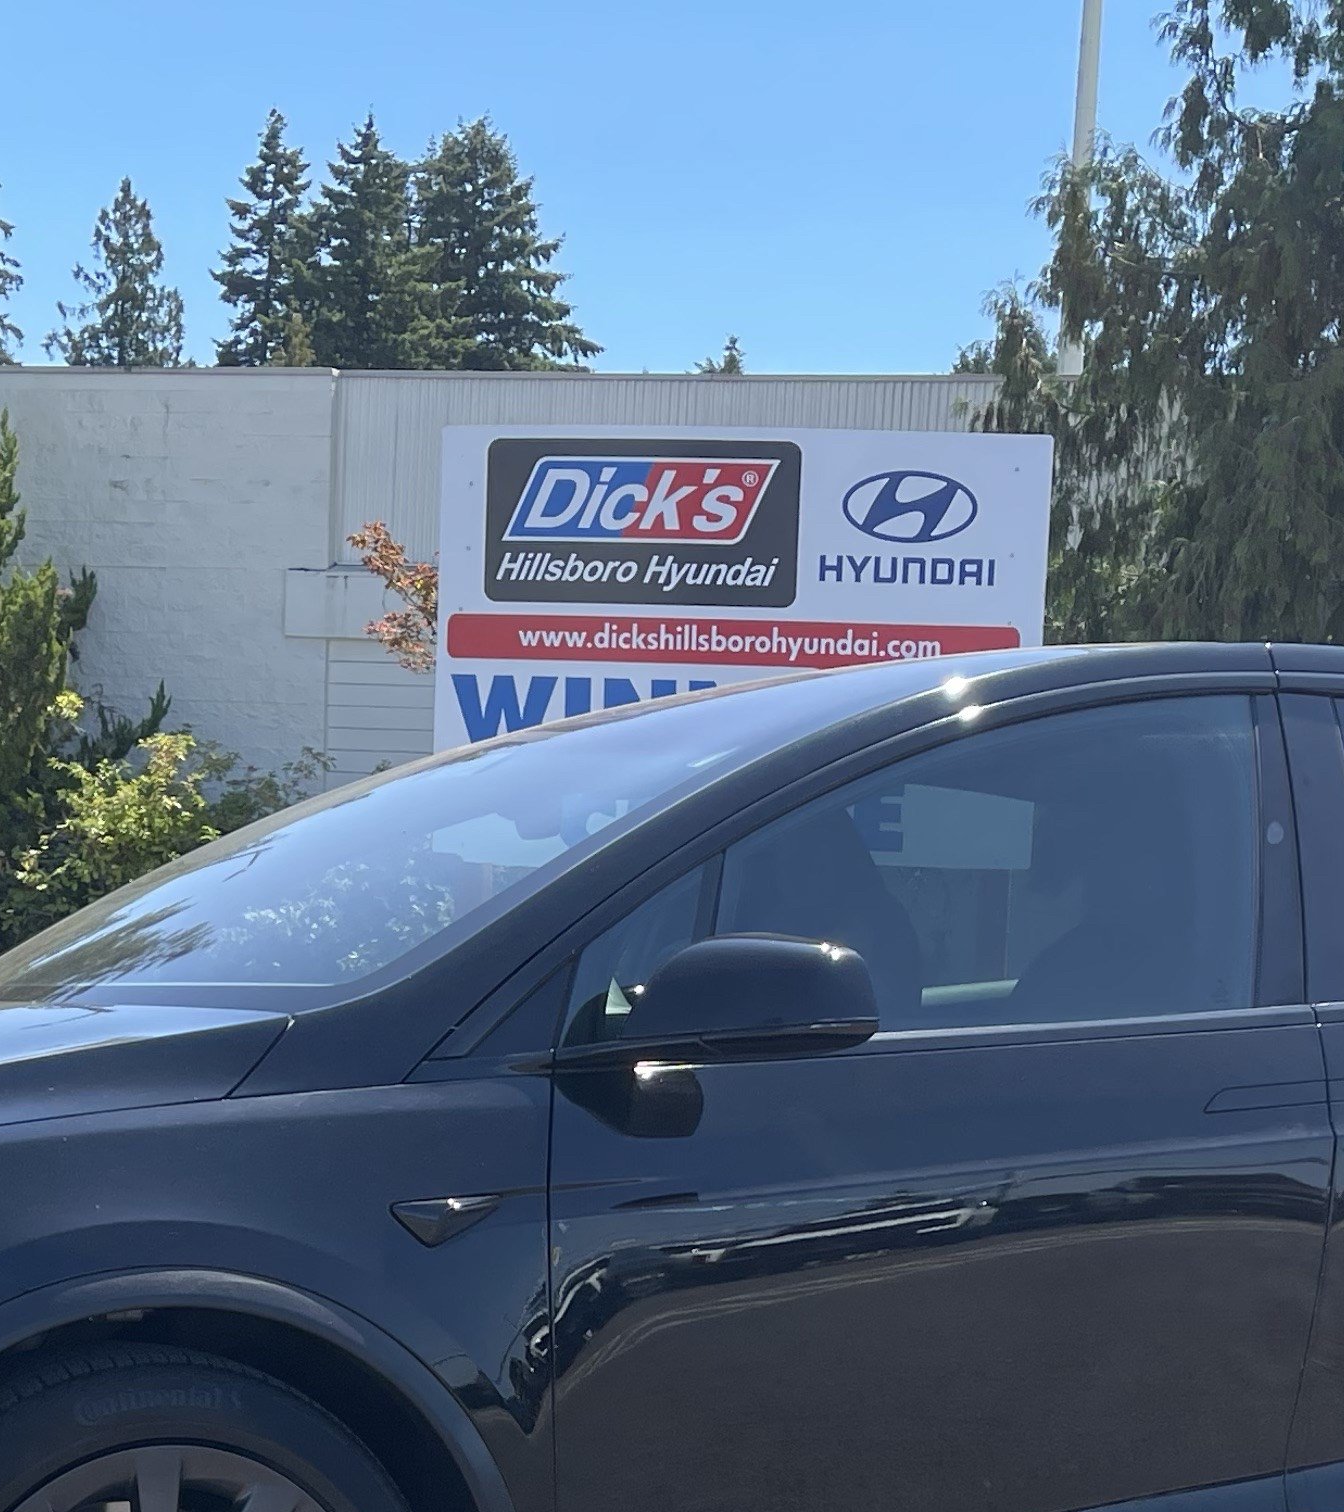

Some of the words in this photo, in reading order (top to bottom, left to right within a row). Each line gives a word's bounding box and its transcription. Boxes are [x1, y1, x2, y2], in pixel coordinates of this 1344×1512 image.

[524, 466, 744, 532] Dick's
[496, 552, 639, 583] Hillsboro
[643, 555, 779, 592] Hyundai
[819, 555, 995, 586] HYUNDAI
[518, 623, 942, 661] www.dickshillsborohyundai.com
